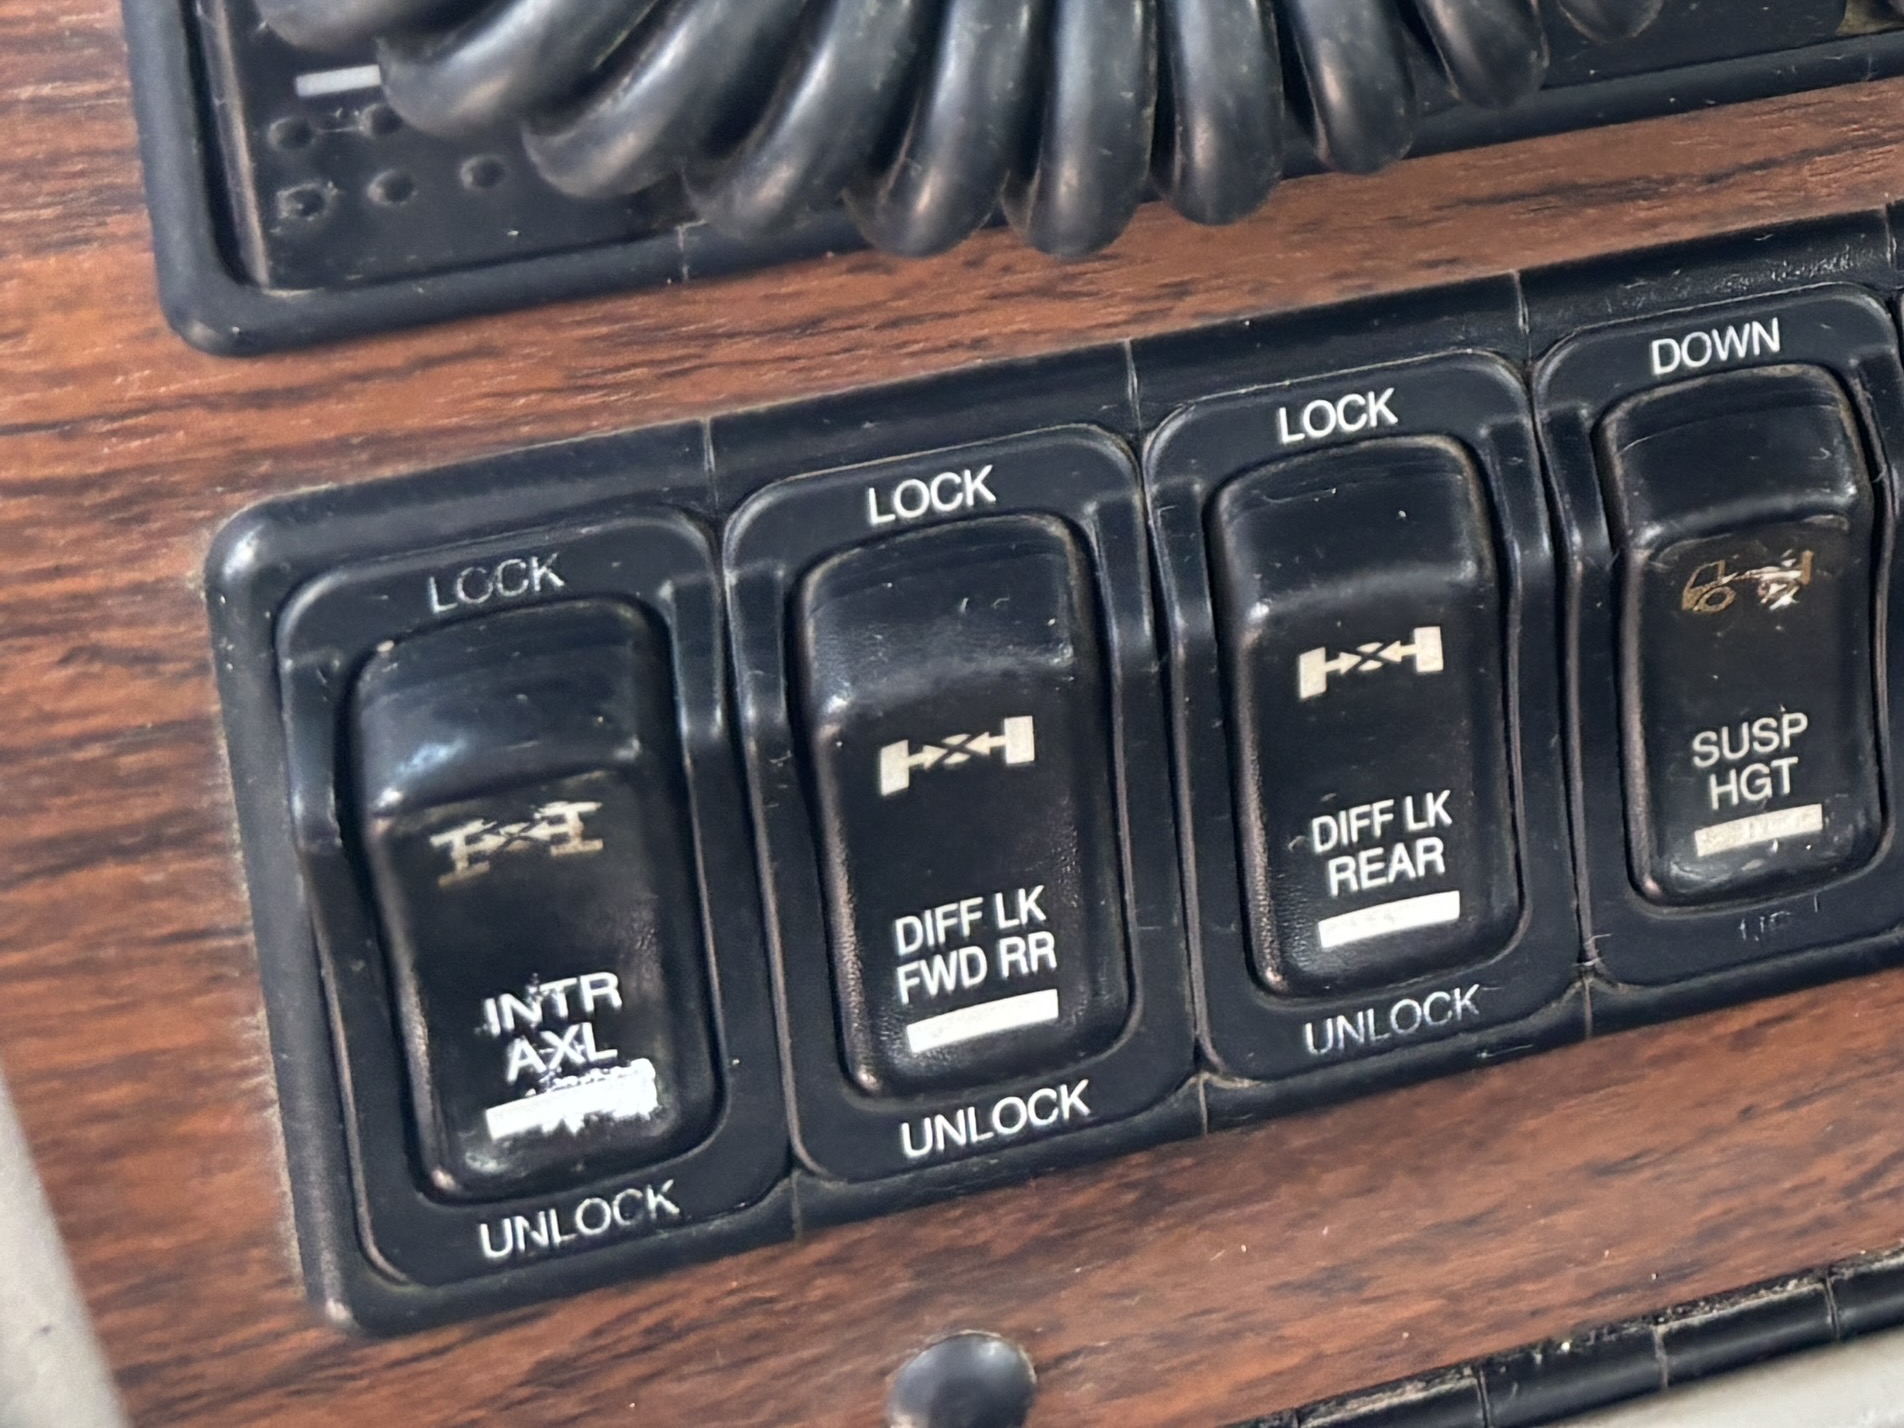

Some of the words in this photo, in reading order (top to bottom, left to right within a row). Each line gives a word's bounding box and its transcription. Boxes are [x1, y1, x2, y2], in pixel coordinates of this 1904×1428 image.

[1649, 317, 1781, 379] DOWN
[1276, 387, 1398, 445] LOCK
[867, 464, 997, 526] LOCK
[427, 552, 566, 615] LOCK
[1691, 713, 1809, 770] SUSP
[1707, 758, 1799, 811] HGT
[1310, 800, 1401, 856] DIFF
[1406, 789, 1453, 833] LK
[1326, 839, 1446, 896] REAR
[895, 897, 985, 955] DIFF
[993, 884, 1047, 930] LK
[897, 945, 988, 1005] FWD
[998, 930, 1058, 979] RR
[478, 972, 623, 1037] INTR
[1303, 984, 1481, 1058] UNLOCK
[505, 1026, 617, 1082] AXL
[900, 1080, 1091, 1158] UNLOCK
[478, 1180, 681, 1261] UNLOCK
